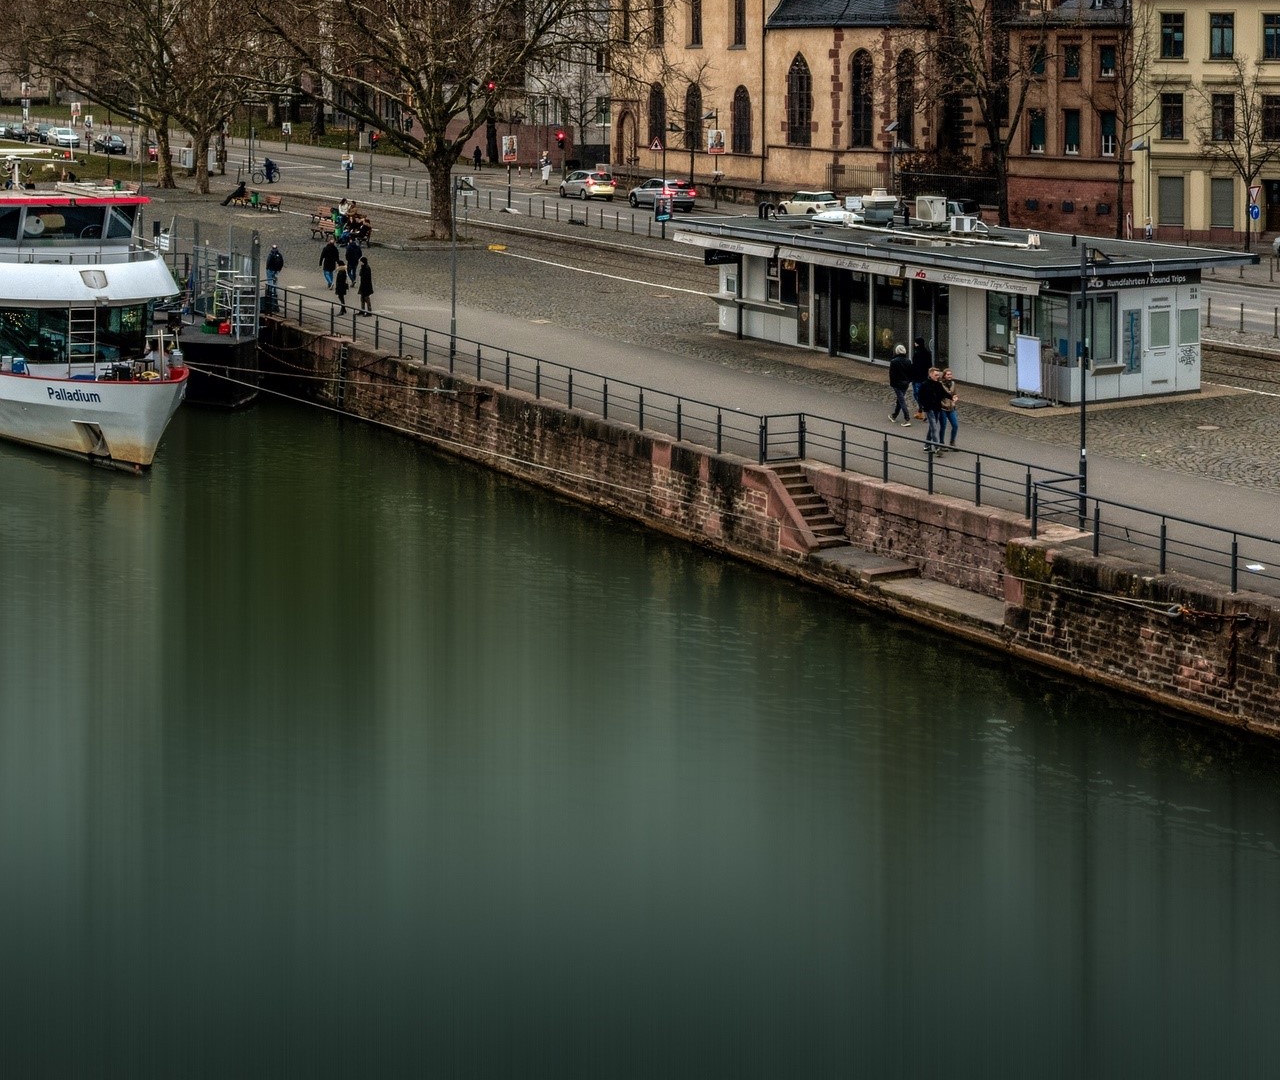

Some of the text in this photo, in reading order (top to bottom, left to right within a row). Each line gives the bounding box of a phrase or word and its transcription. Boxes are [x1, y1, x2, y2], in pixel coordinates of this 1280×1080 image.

[1107, 279, 1145, 287] Rundfahrten
[1150, 275, 1171, 285] Round
[1171, 274, 1187, 284] Trips
[47, 387, 101, 402] Palladium
